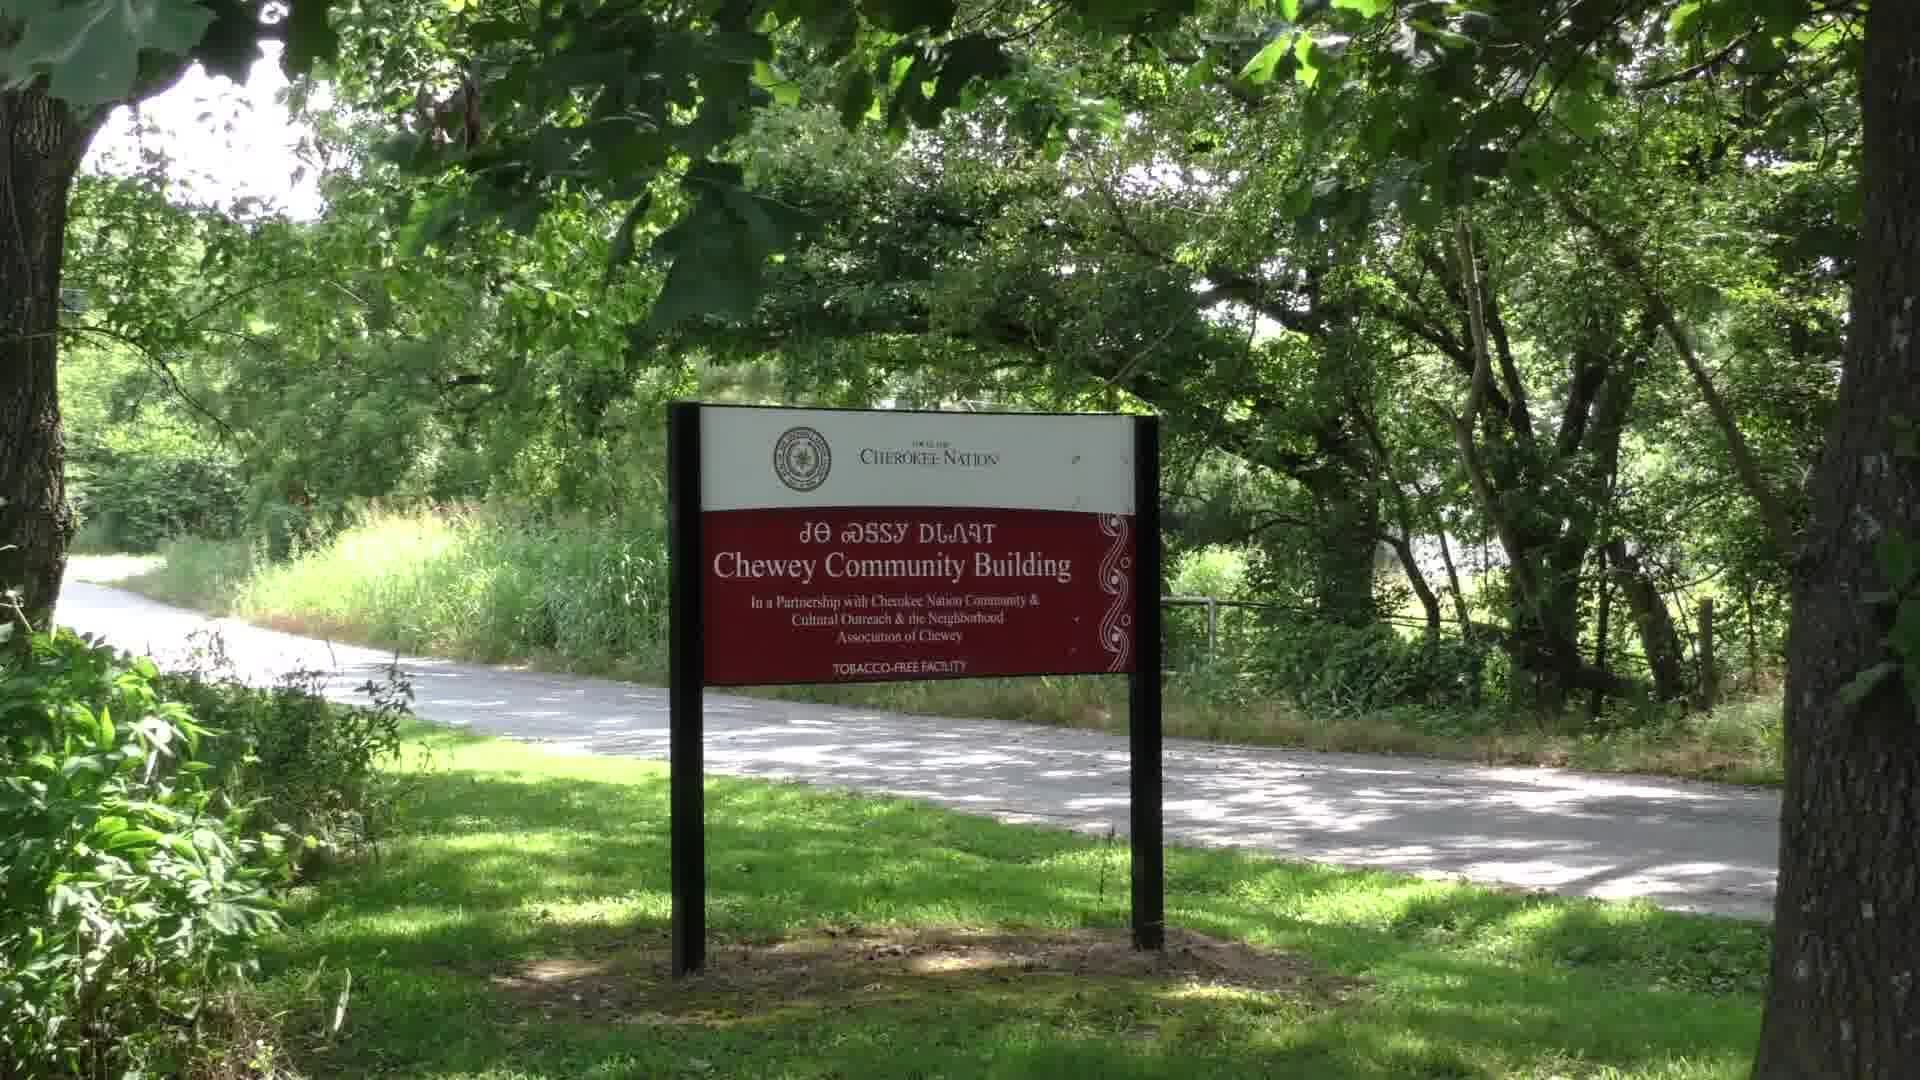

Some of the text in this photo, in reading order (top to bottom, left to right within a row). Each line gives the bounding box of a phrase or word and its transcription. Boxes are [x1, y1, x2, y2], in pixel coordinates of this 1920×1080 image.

[713, 551, 1072, 584] Chewey Community Building
[751, 593, 1041, 610] In a Partnership with Cherokee Nation Community &
[791, 610, 1004, 627] Cultural Outreach & the Neighborhood
[838, 629, 962, 644] Association of Chewey
[833, 660, 967, 675] TOBACCO-FREE FACILITY
